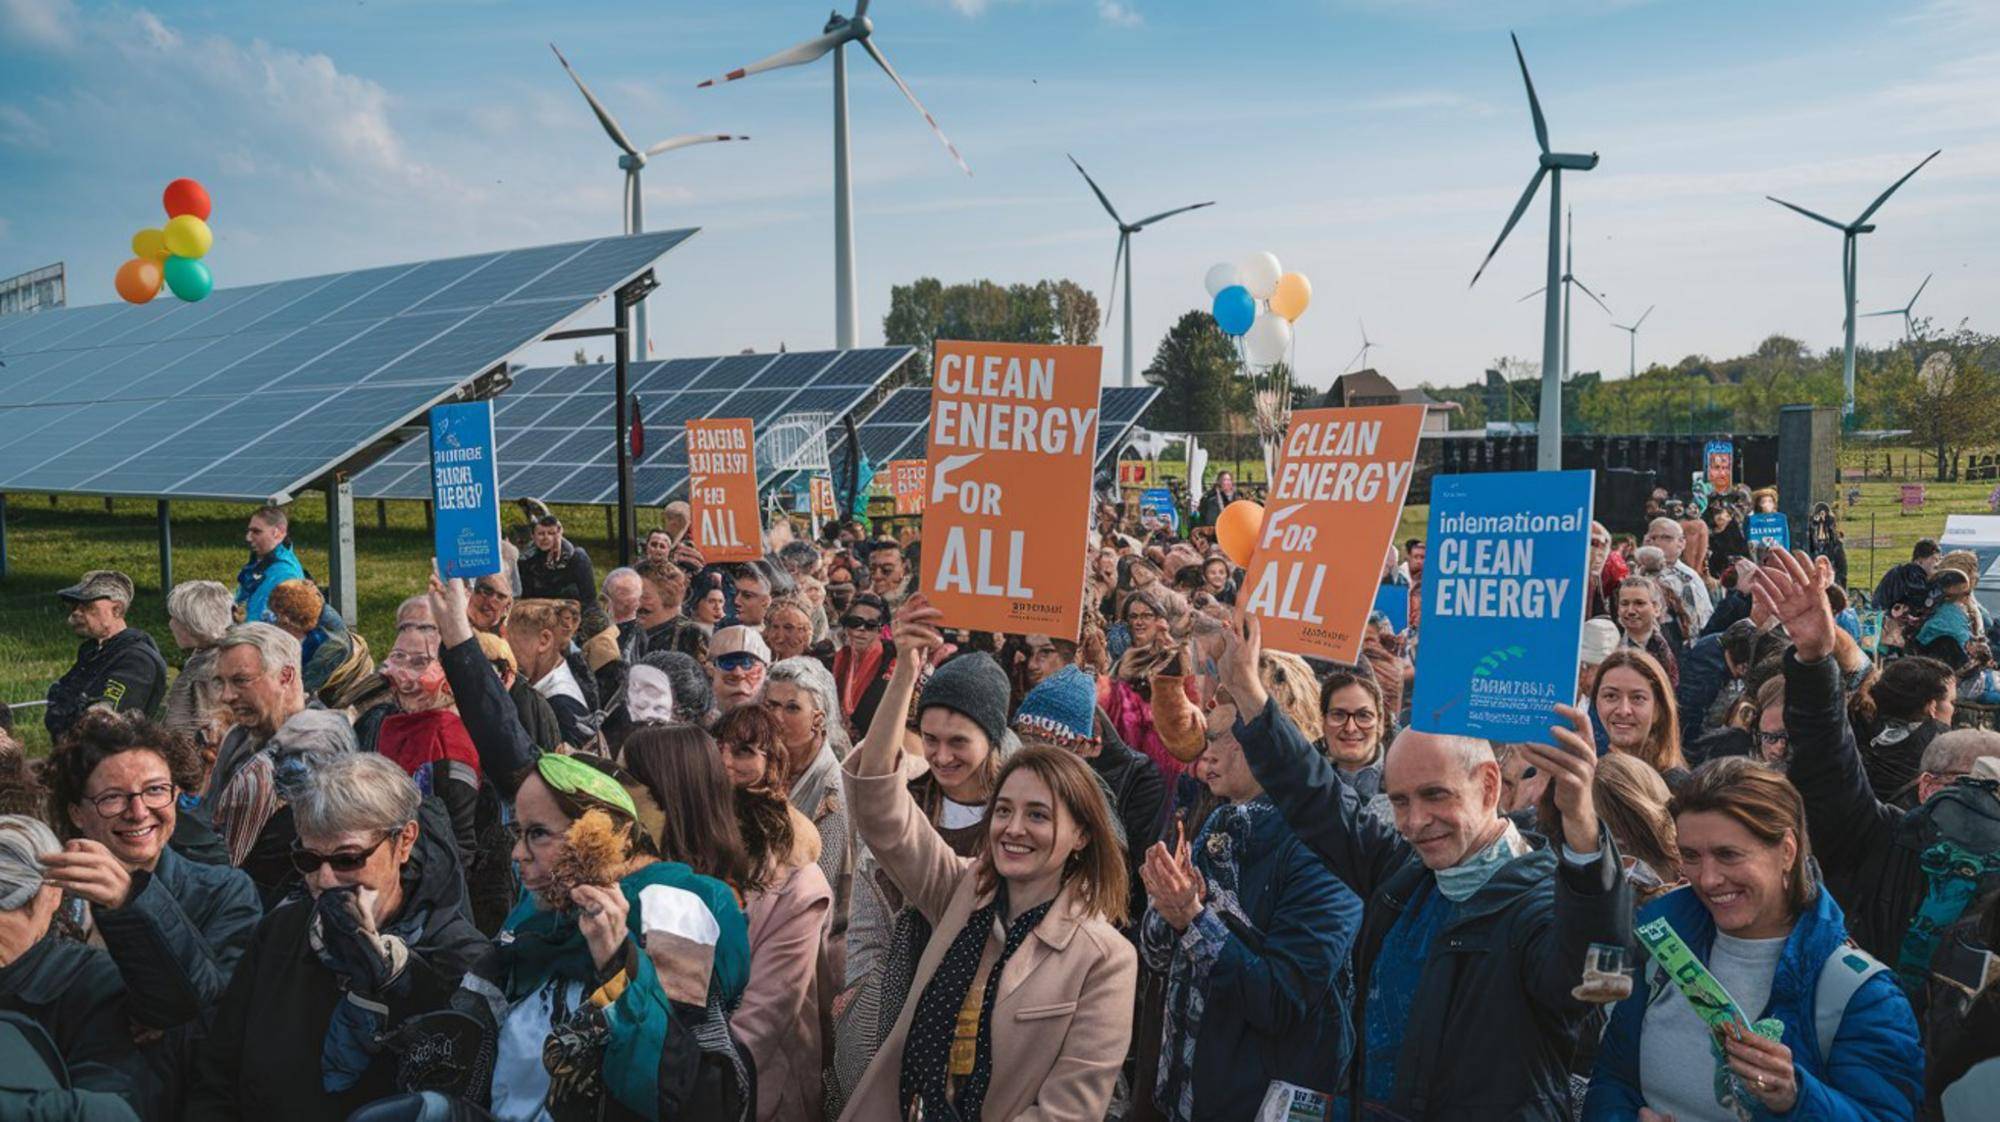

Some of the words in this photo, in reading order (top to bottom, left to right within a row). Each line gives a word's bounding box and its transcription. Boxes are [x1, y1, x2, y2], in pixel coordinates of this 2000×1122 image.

[938, 353, 1055, 400] CLEAN
[935, 400, 1097, 455] ENERGY
[1287, 421, 1382, 457] CLEAN
[932, 452, 1002, 516] FOR
[1276, 461, 1411, 503] ENERGY
[1262, 502, 1317, 552] FOR
[934, 526, 1034, 599] ALL
[1438, 538, 1534, 576] CLEAN
[1246, 560, 1327, 625] ALL
[1435, 578, 1570, 619] ENERGY
